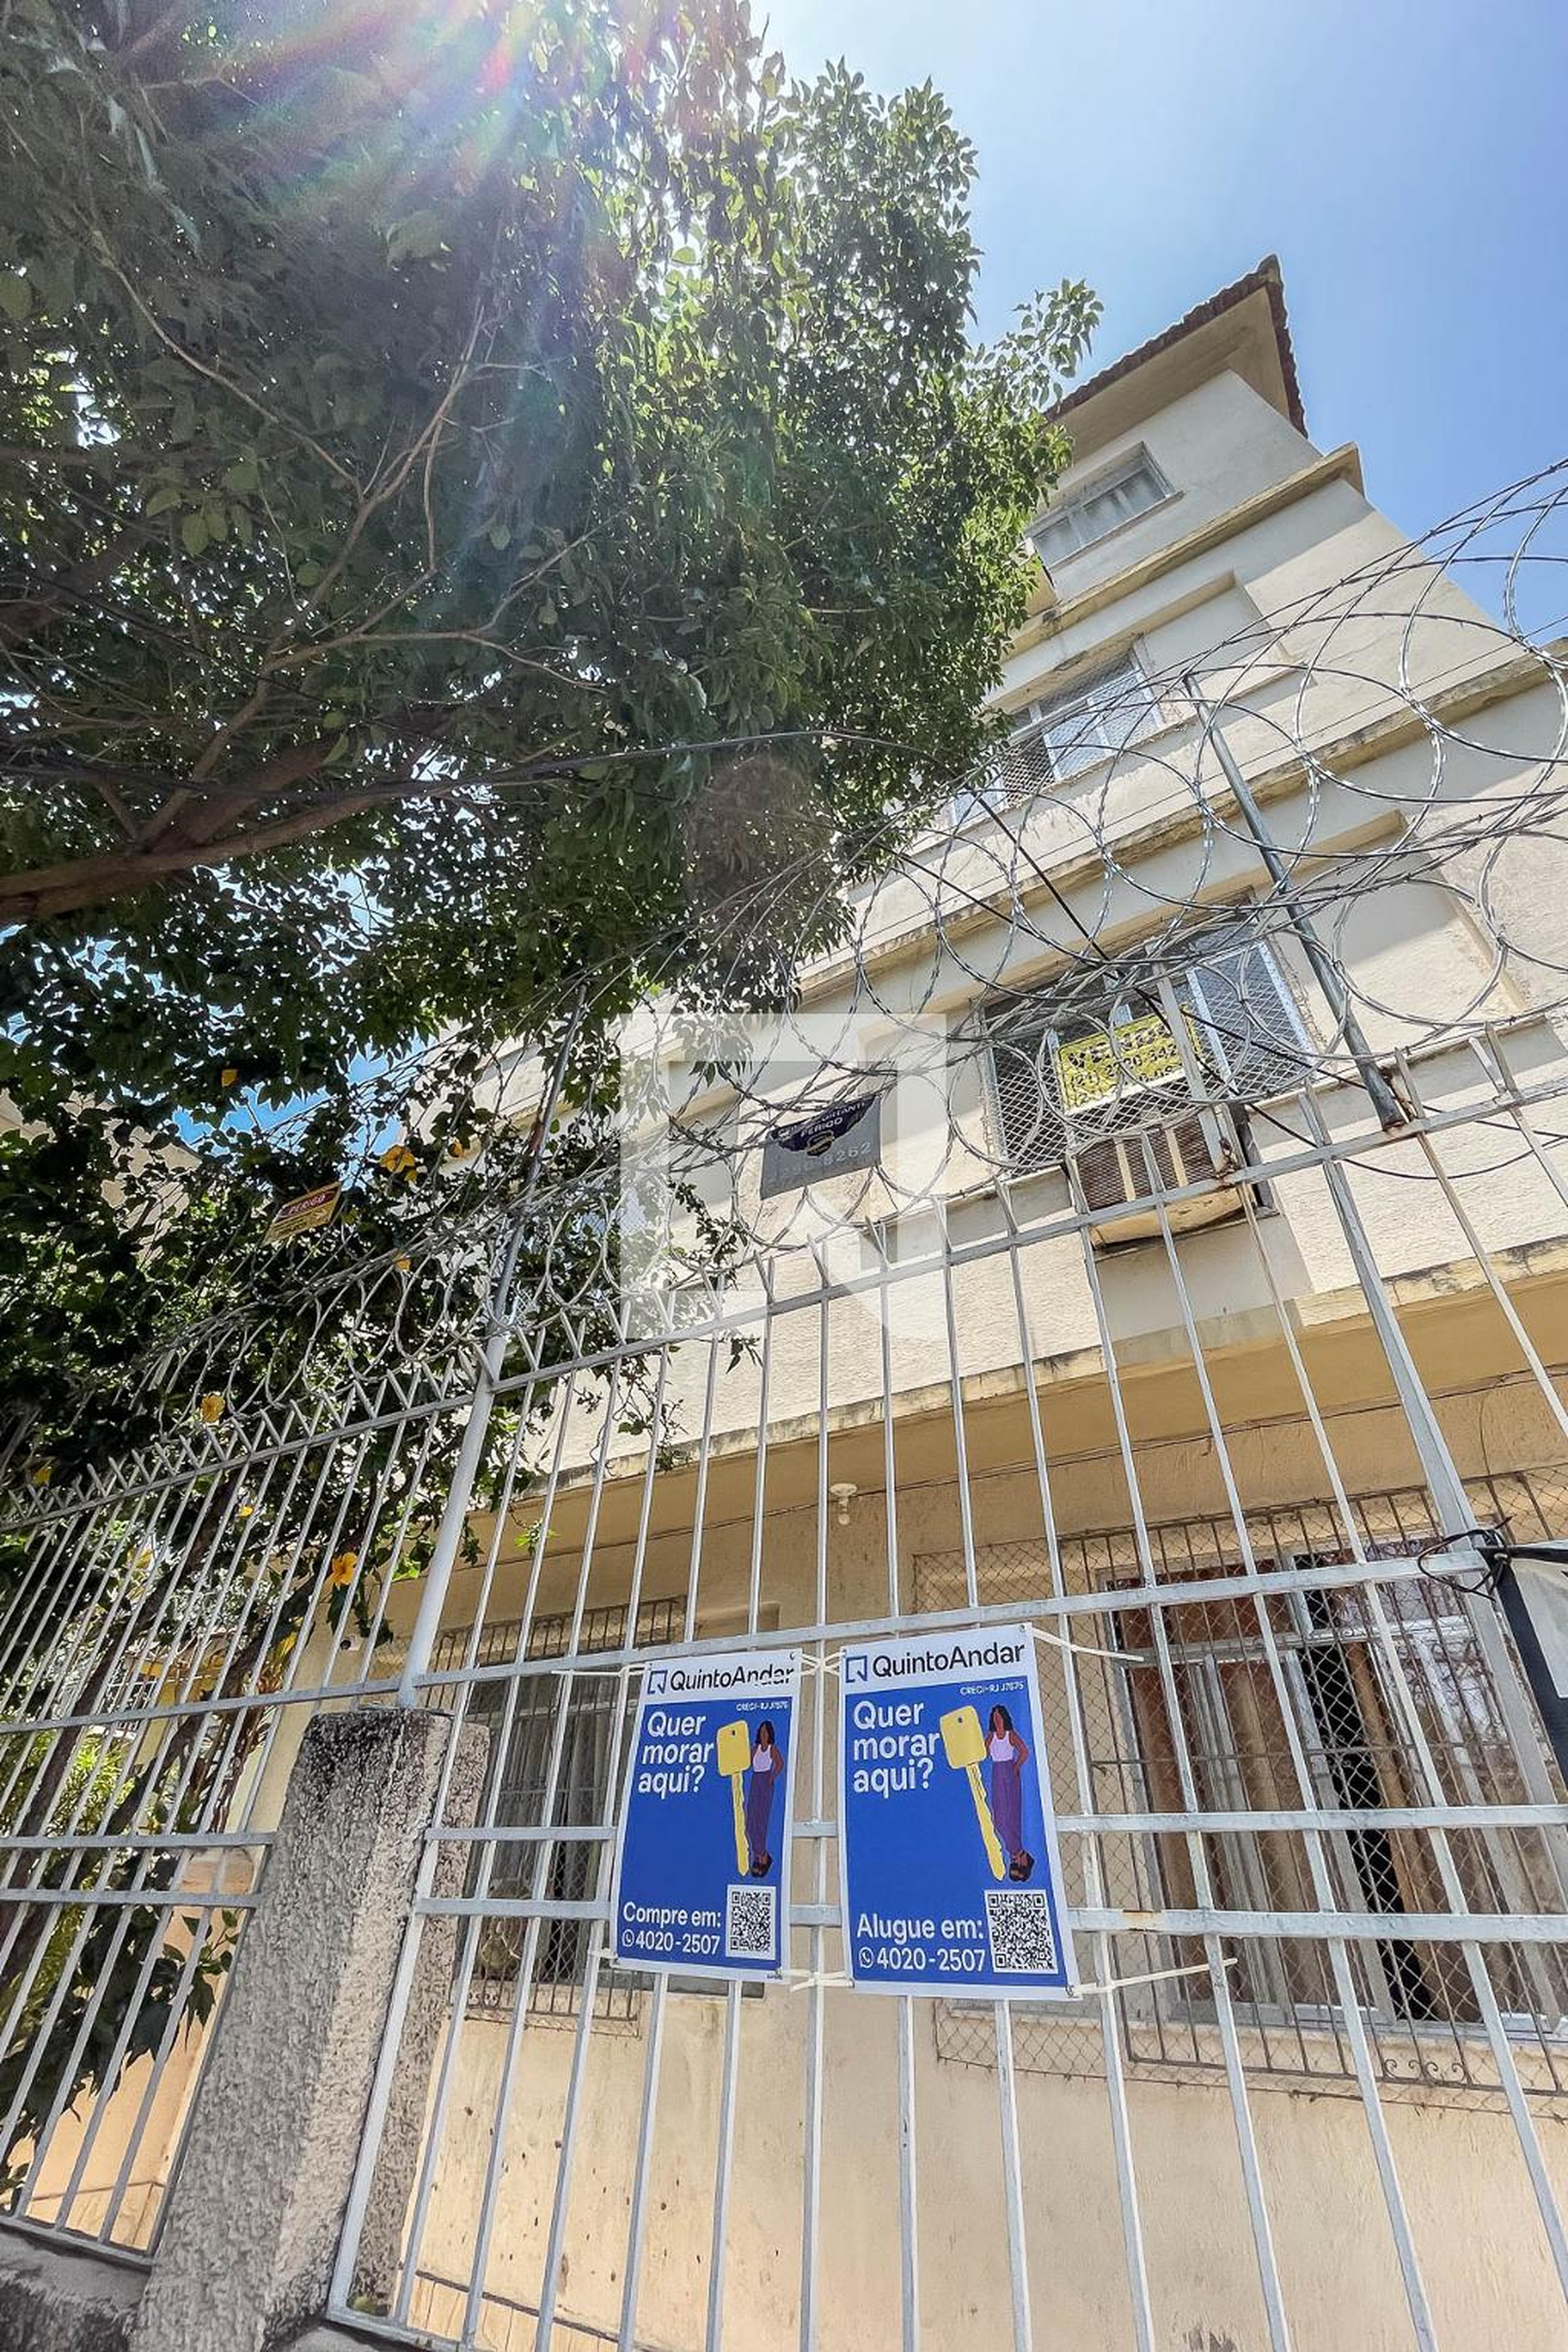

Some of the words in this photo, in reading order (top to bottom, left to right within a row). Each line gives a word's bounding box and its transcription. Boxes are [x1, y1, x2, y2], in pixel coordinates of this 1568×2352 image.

[873, 1642, 1025, 1677] QuintoAndar
[670, 1664, 795, 1691] QuintoAndar
[647, 1711, 706, 1737] Quer
[853, 1700, 924, 1730] Quer
[641, 1742, 715, 1764] morar
[853, 1733, 940, 1761] morar
[637, 1765, 705, 1799] aqui?
[853, 1757, 933, 1798] aqui?
[623, 1901, 688, 1928] Compre
[691, 1909, 721, 1927] em:
[635, 1930, 721, 1955] 4020-2507
[857, 1913, 935, 1945] Alugue
[941, 1919, 984, 1939] em:
[877, 1947, 986, 1971] 4020-2507
